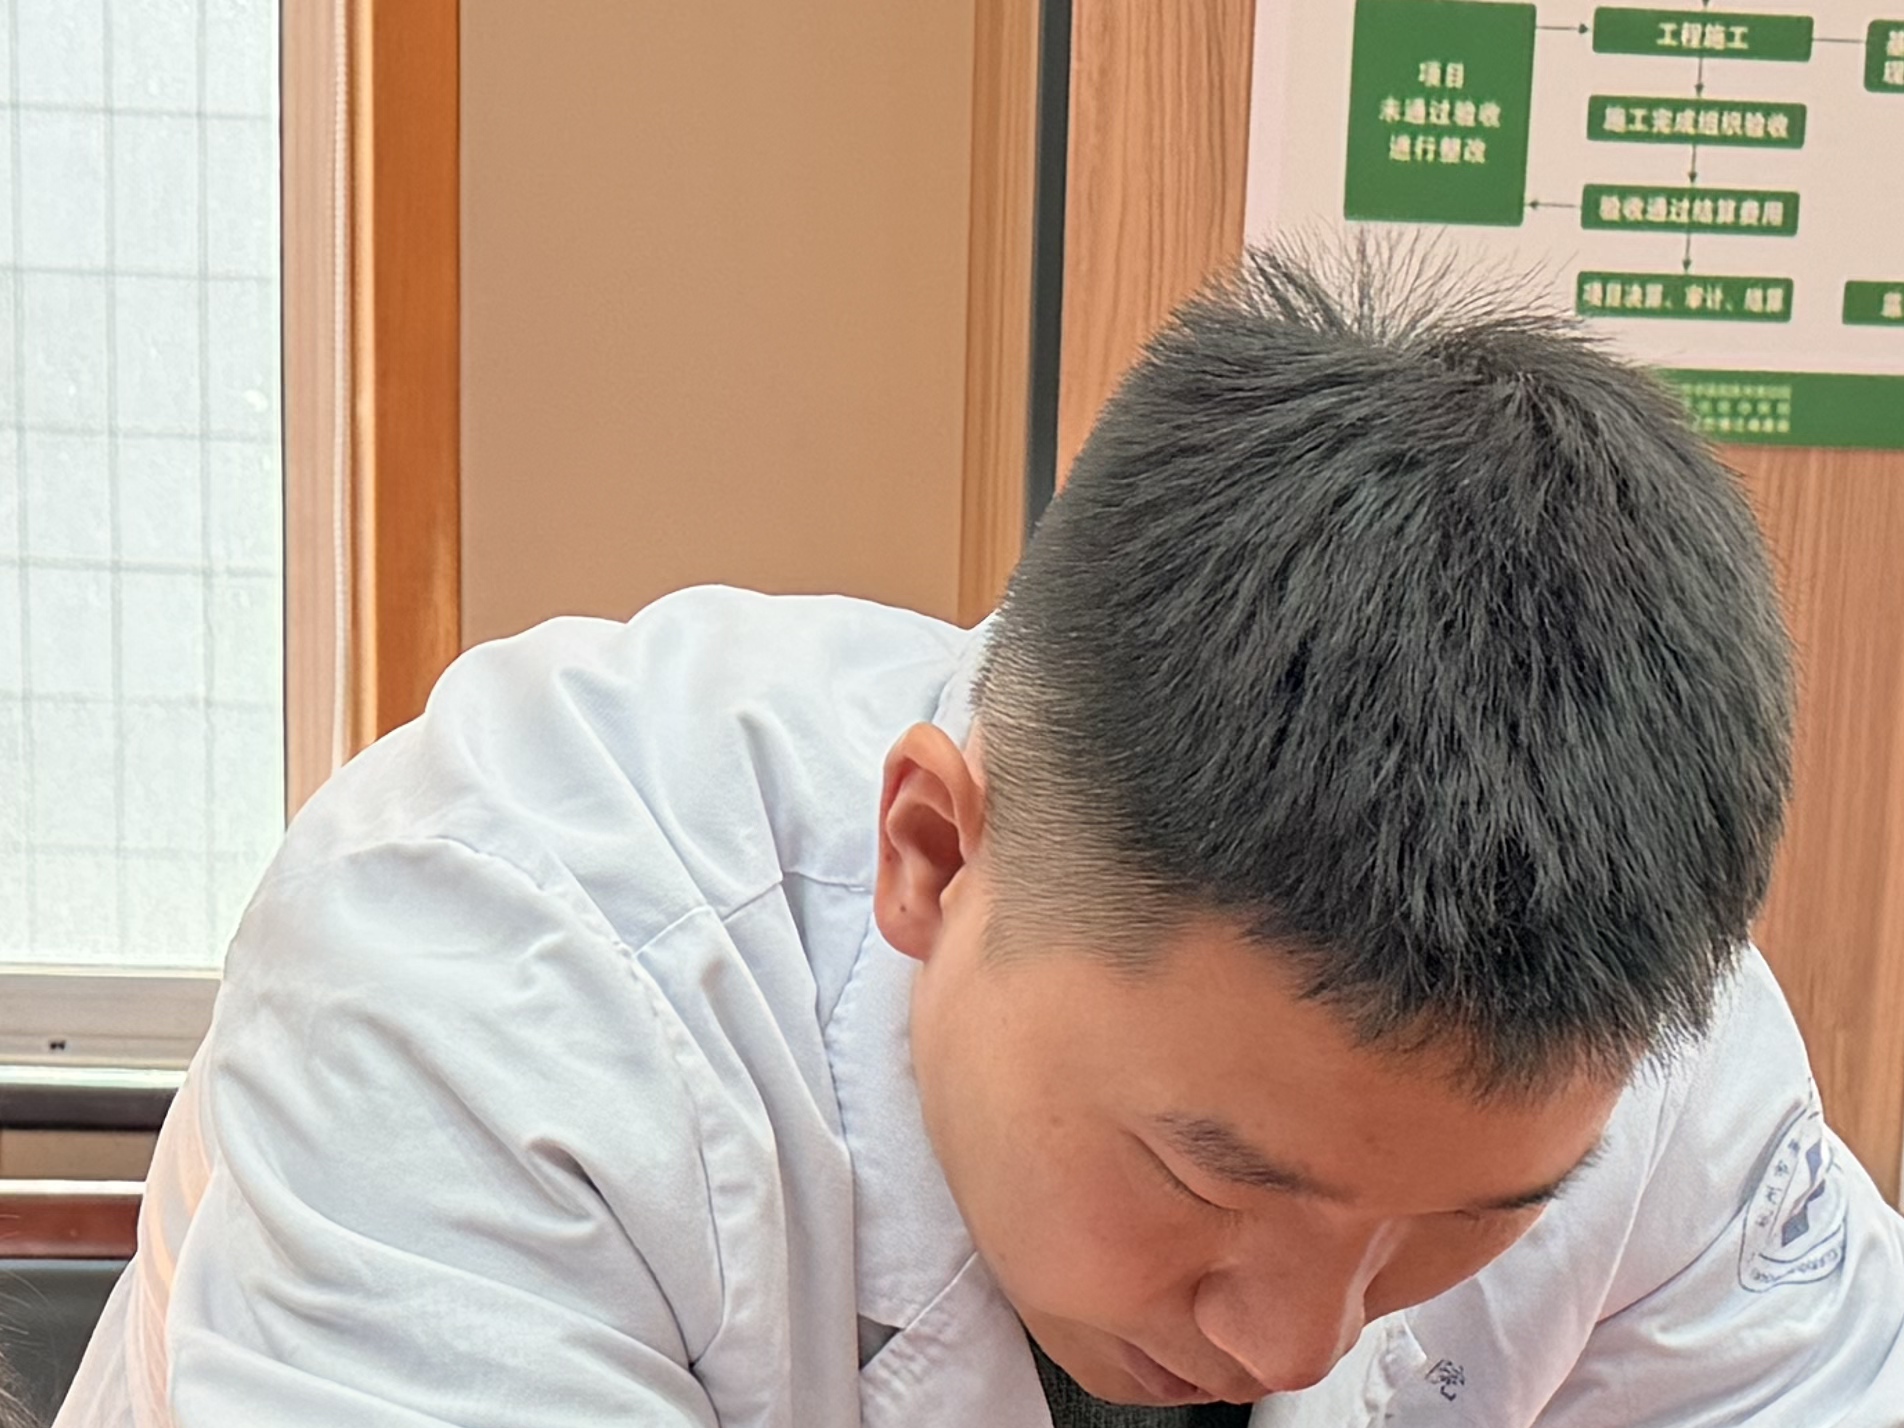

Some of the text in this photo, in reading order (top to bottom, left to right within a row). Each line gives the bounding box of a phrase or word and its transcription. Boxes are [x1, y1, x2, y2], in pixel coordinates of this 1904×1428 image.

[1656, 20, 1749, 50] 工程施工
[1418, 59, 1465, 89] 项目
[1378, 94, 1502, 128] 未通过验收
[1602, 105, 1789, 139] 施工完成组织验收
[1599, 194, 1784, 227] 验收通过结算费用
